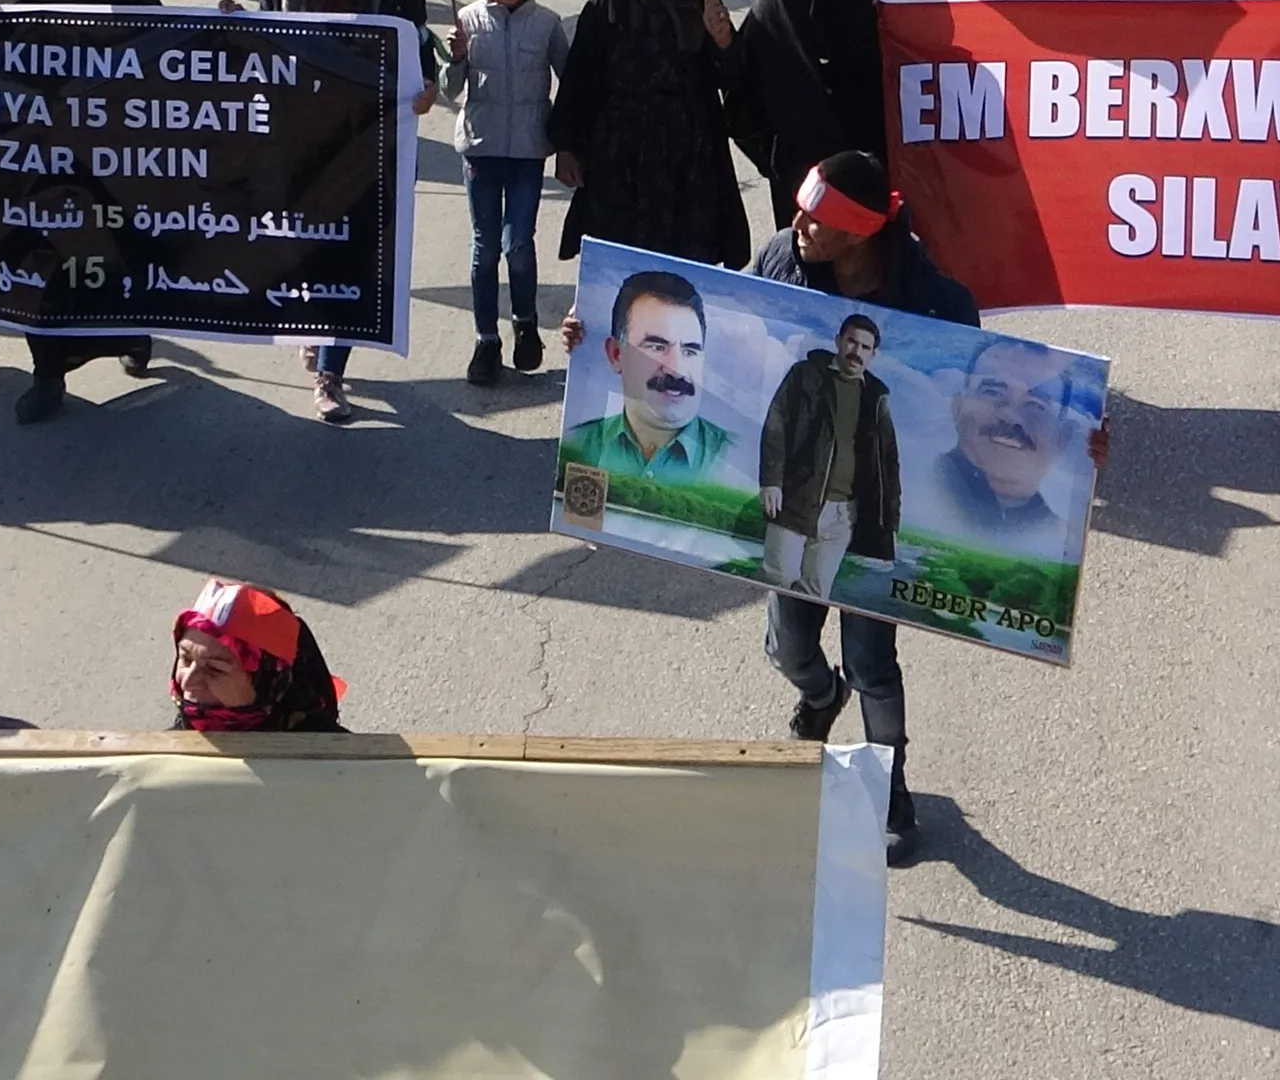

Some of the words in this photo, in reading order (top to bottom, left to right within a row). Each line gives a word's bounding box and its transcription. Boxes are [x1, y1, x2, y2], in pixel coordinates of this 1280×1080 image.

[159, 49, 297, 86] GELAN
[66, 97, 107, 127] 15
[124, 92, 271, 134] SIBATÊ
[899, 61, 1006, 143] EM
[92, 147, 208, 178] DIKIN
[92, 204, 124, 229] 15
[133, 202, 241, 239] مؤامرة
[247, 209, 350, 241] نستنكر
[61, 255, 106, 289] 15
[889, 578, 988, 622] RÊBER
[995, 607, 1056, 638] APO
